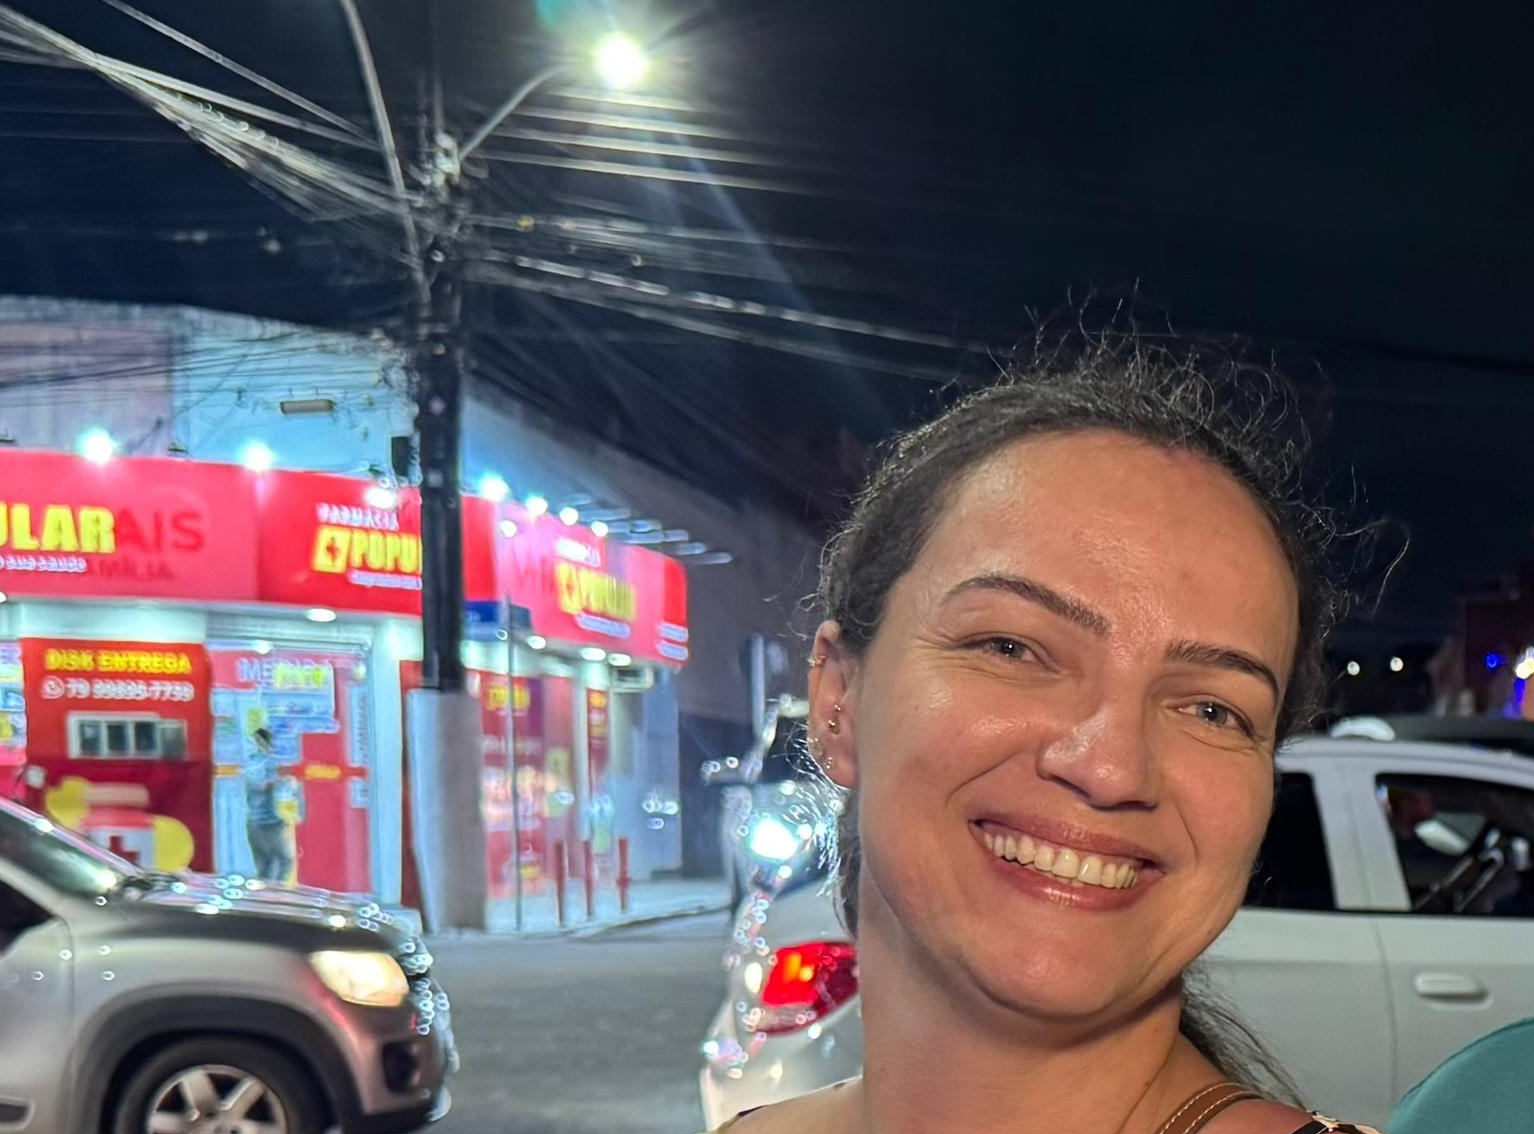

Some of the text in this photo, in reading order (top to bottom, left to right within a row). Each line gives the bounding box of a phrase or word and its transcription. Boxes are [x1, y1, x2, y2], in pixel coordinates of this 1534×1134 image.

[0, 503, 115, 552] LAR
[353, 530, 423, 573] POPU
[46, 648, 94, 671] DISK
[97, 650, 192, 675] ENTREGA
